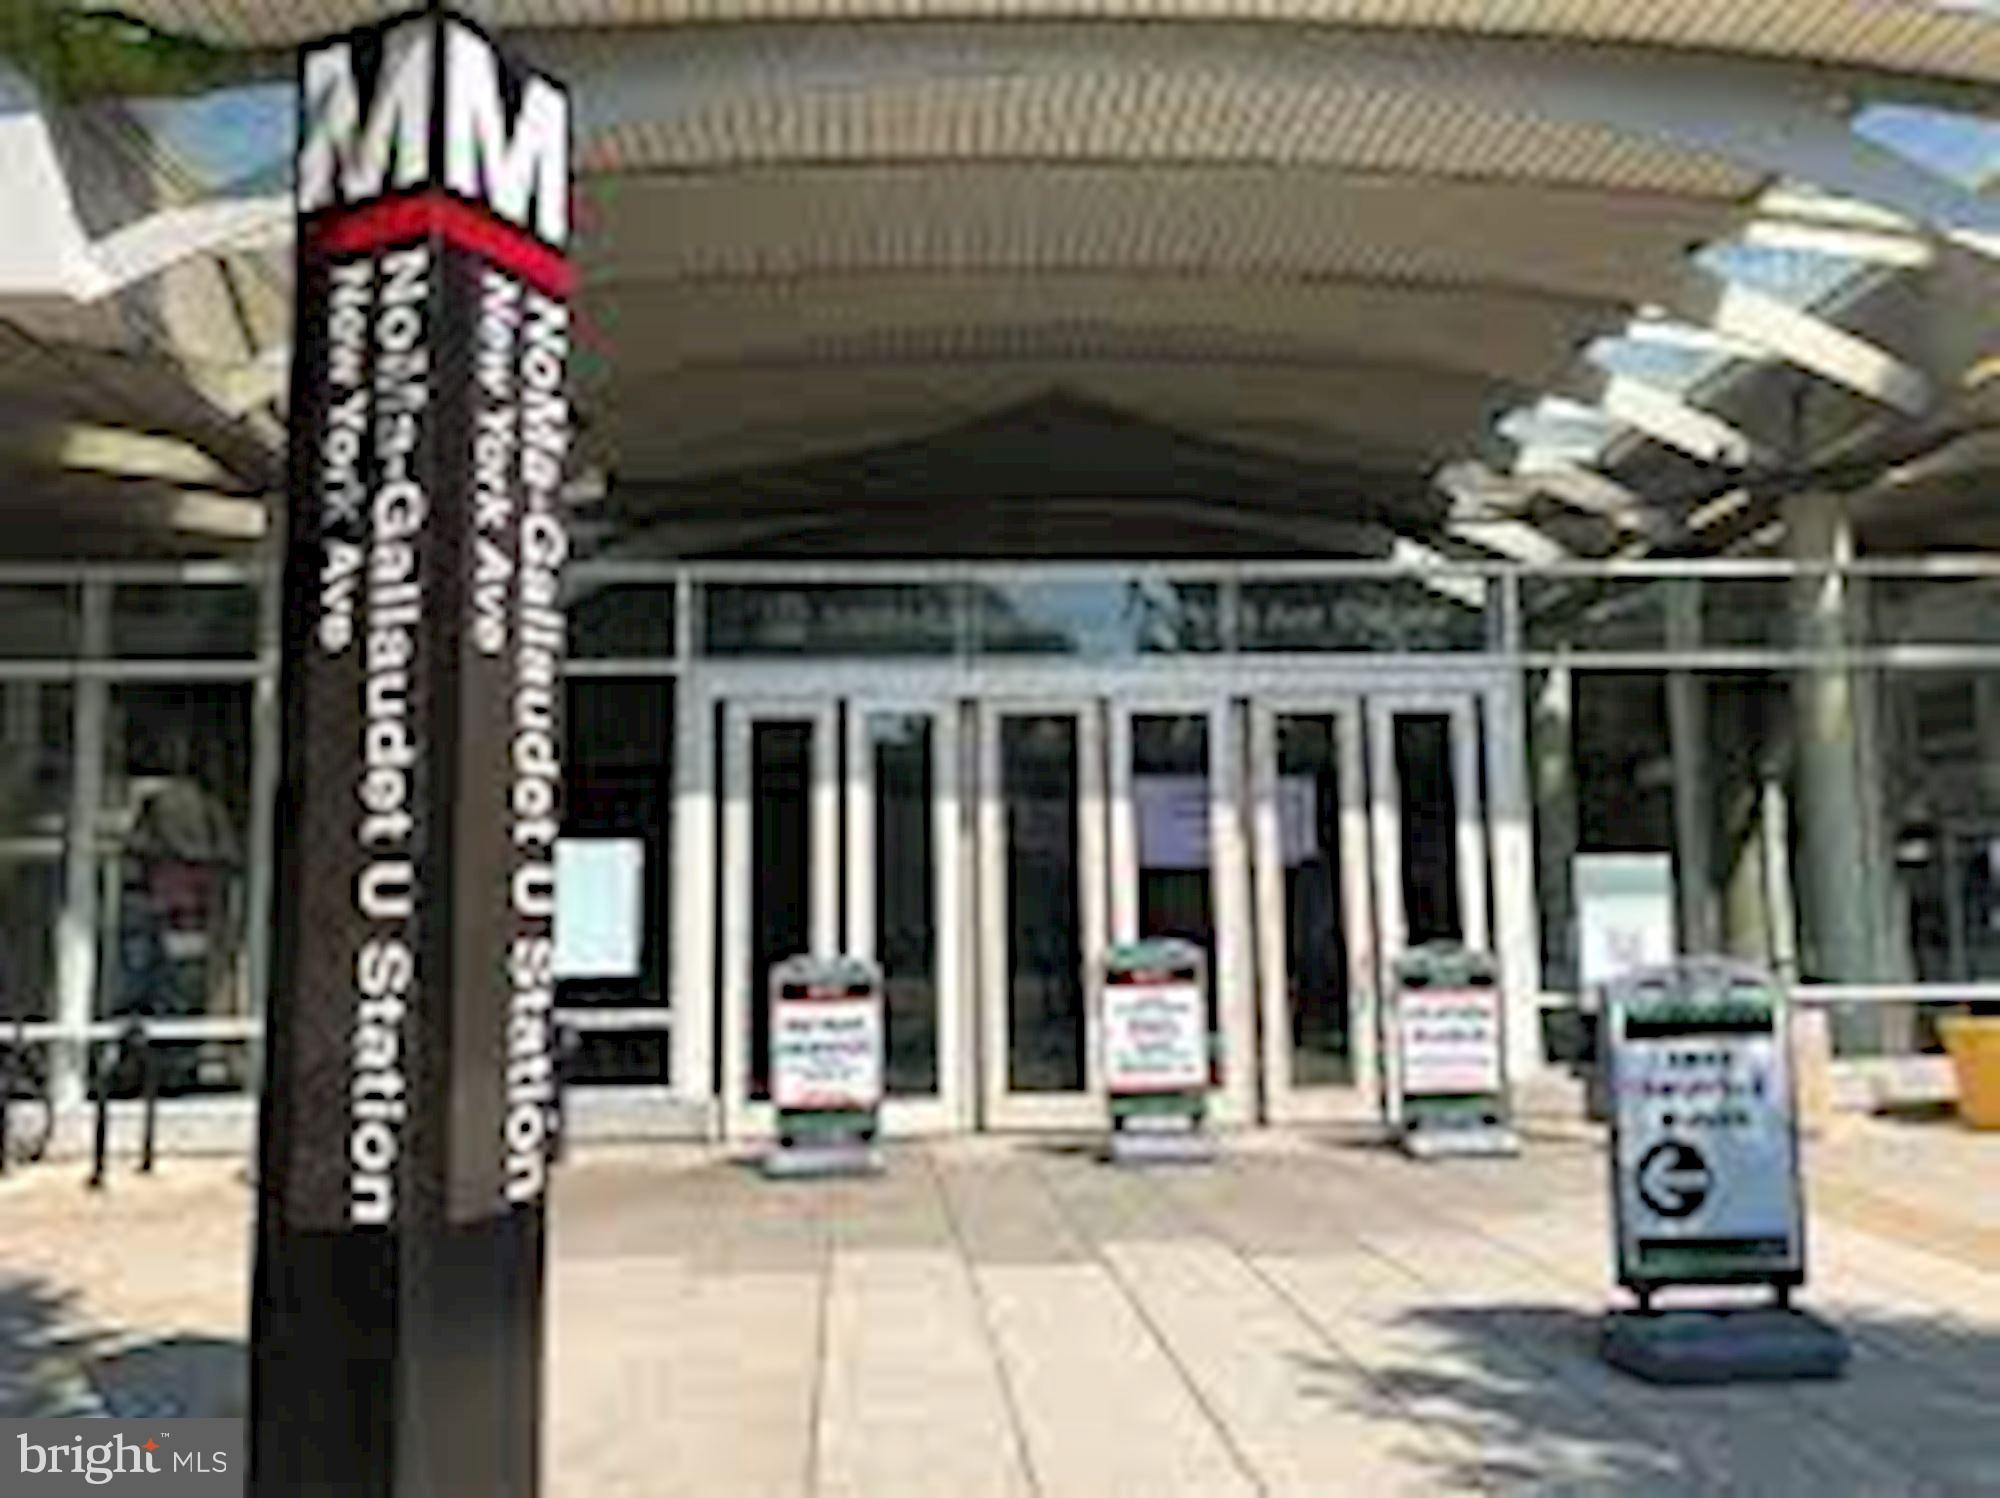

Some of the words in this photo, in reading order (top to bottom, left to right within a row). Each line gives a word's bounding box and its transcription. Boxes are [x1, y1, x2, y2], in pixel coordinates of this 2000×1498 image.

[298, 17, 434, 213] M
[443, 19, 569, 245] M
[326, 258, 373, 386] New
[474, 272, 521, 398] New
[319, 391, 369, 526] York
[472, 404, 519, 528] York
[319, 539, 363, 654] Ave
[472, 540, 514, 654] Ave
[357, 859, 415, 919] U
[511, 872, 556, 918] U
[349, 938, 415, 1225] Station
[505, 936, 556, 1205] Station
